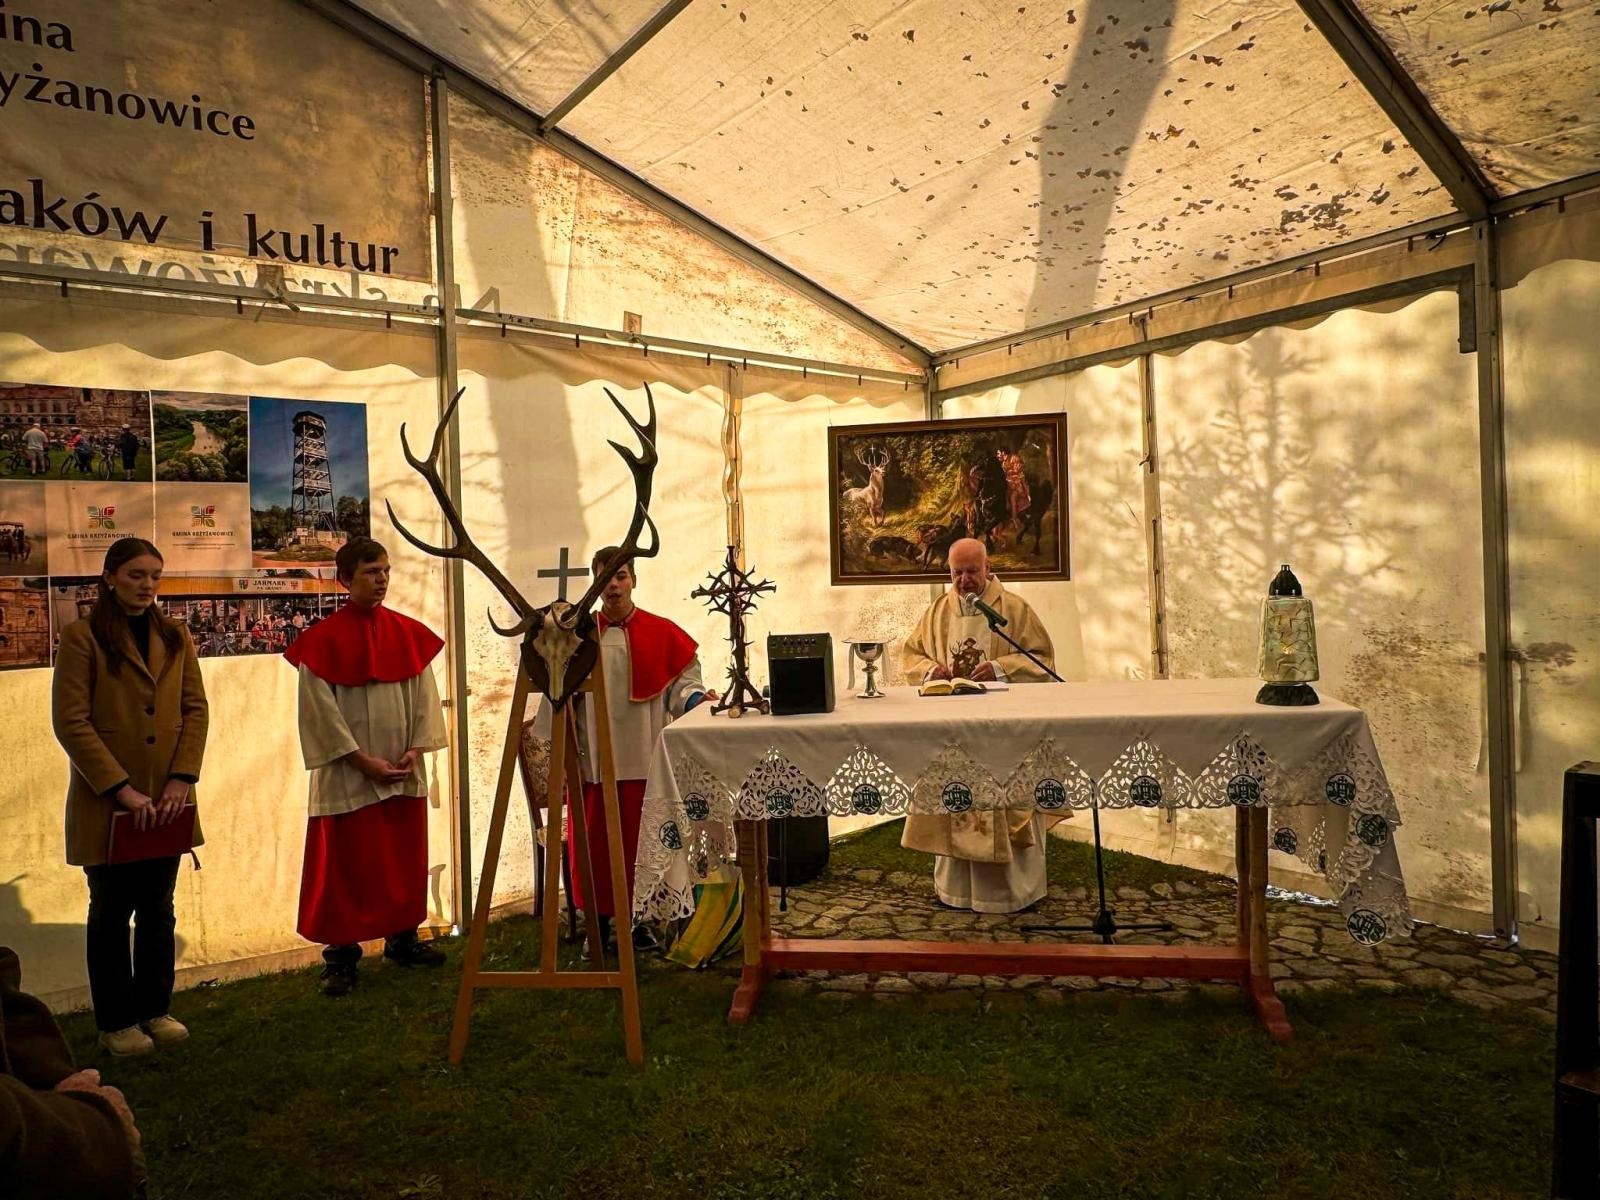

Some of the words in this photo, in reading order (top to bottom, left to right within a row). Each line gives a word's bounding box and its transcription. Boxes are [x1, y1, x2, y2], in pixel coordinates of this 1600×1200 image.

[0, 0, 76, 53] ina
[0, 62, 257, 141] yżanowice
[0, 178, 169, 245] aków
[197, 210, 216, 252] i
[243, 213, 400, 275] kultur
